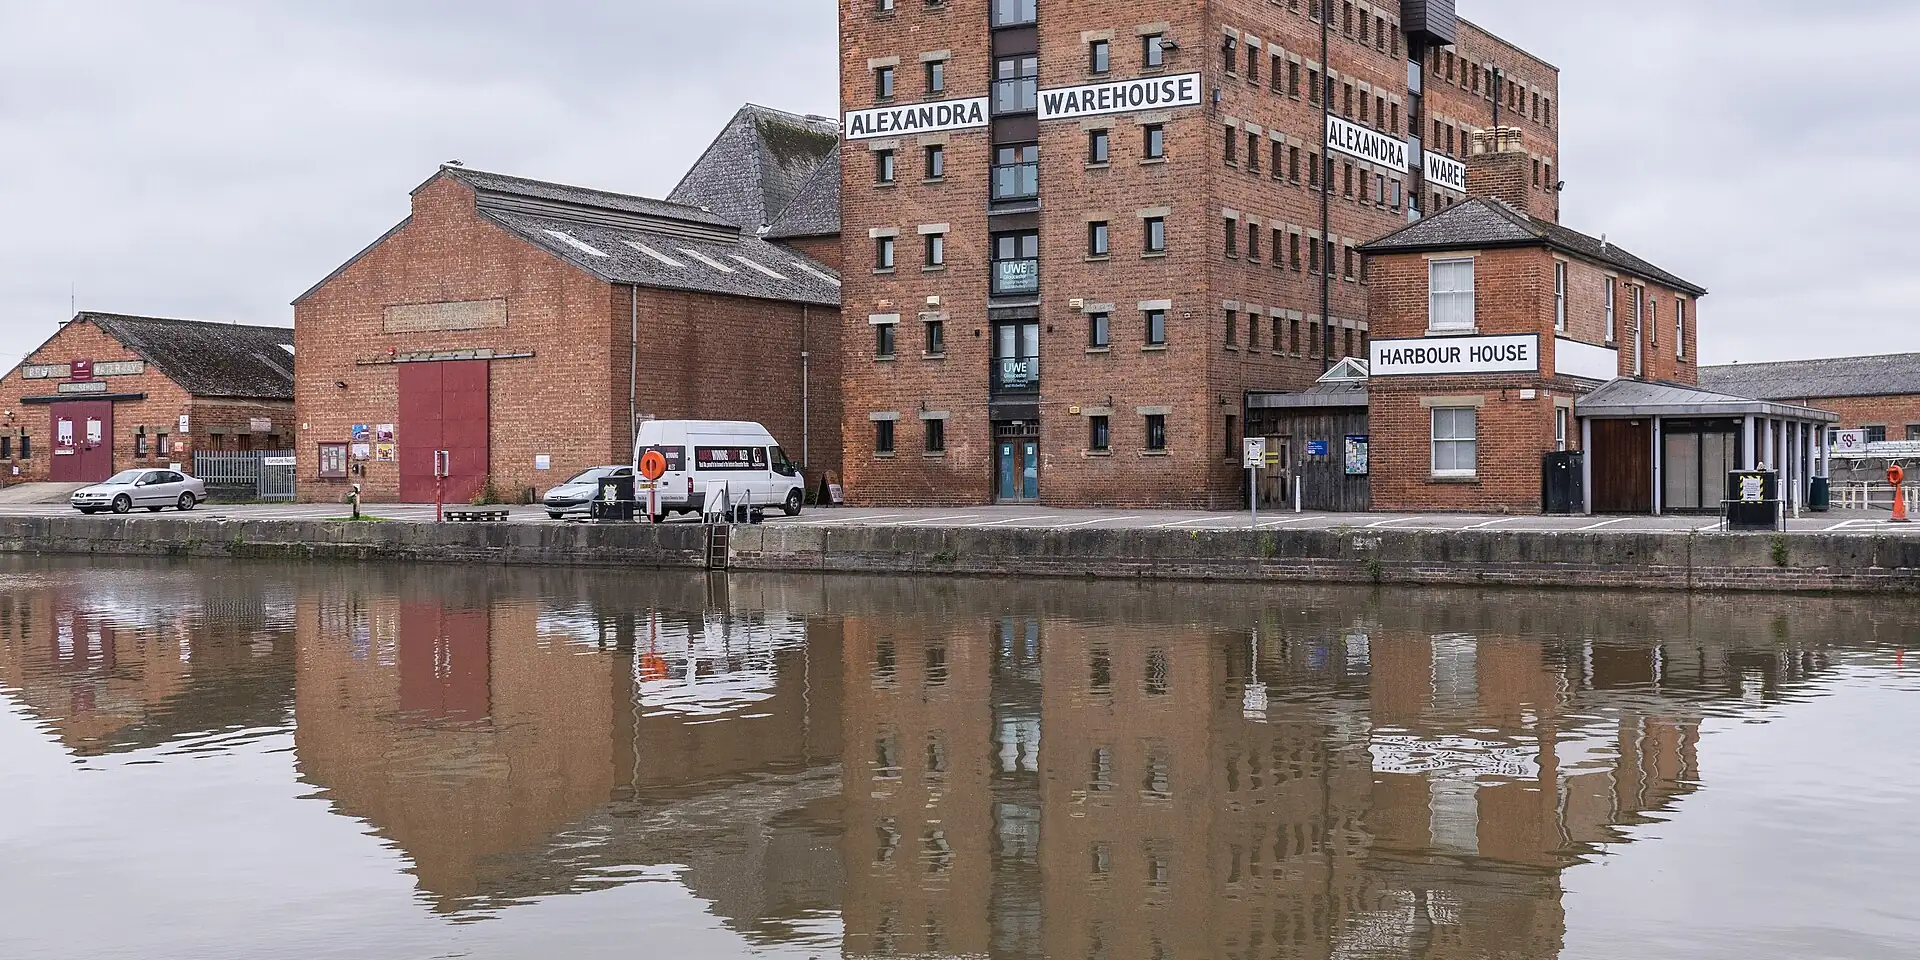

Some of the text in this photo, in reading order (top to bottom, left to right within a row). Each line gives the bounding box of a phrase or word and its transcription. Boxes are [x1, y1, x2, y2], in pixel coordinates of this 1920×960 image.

[850, 77, 1194, 136] ALEXANDRA WAREHOUSE
[1328, 120, 1405, 168] ALEXANDRA
[1003, 263, 1027, 274] UWE
[1380, 344, 1528, 365] HARBOUR HOUSE
[1003, 362, 1027, 373] UWE
[1842, 433, 1857, 448] CSL
